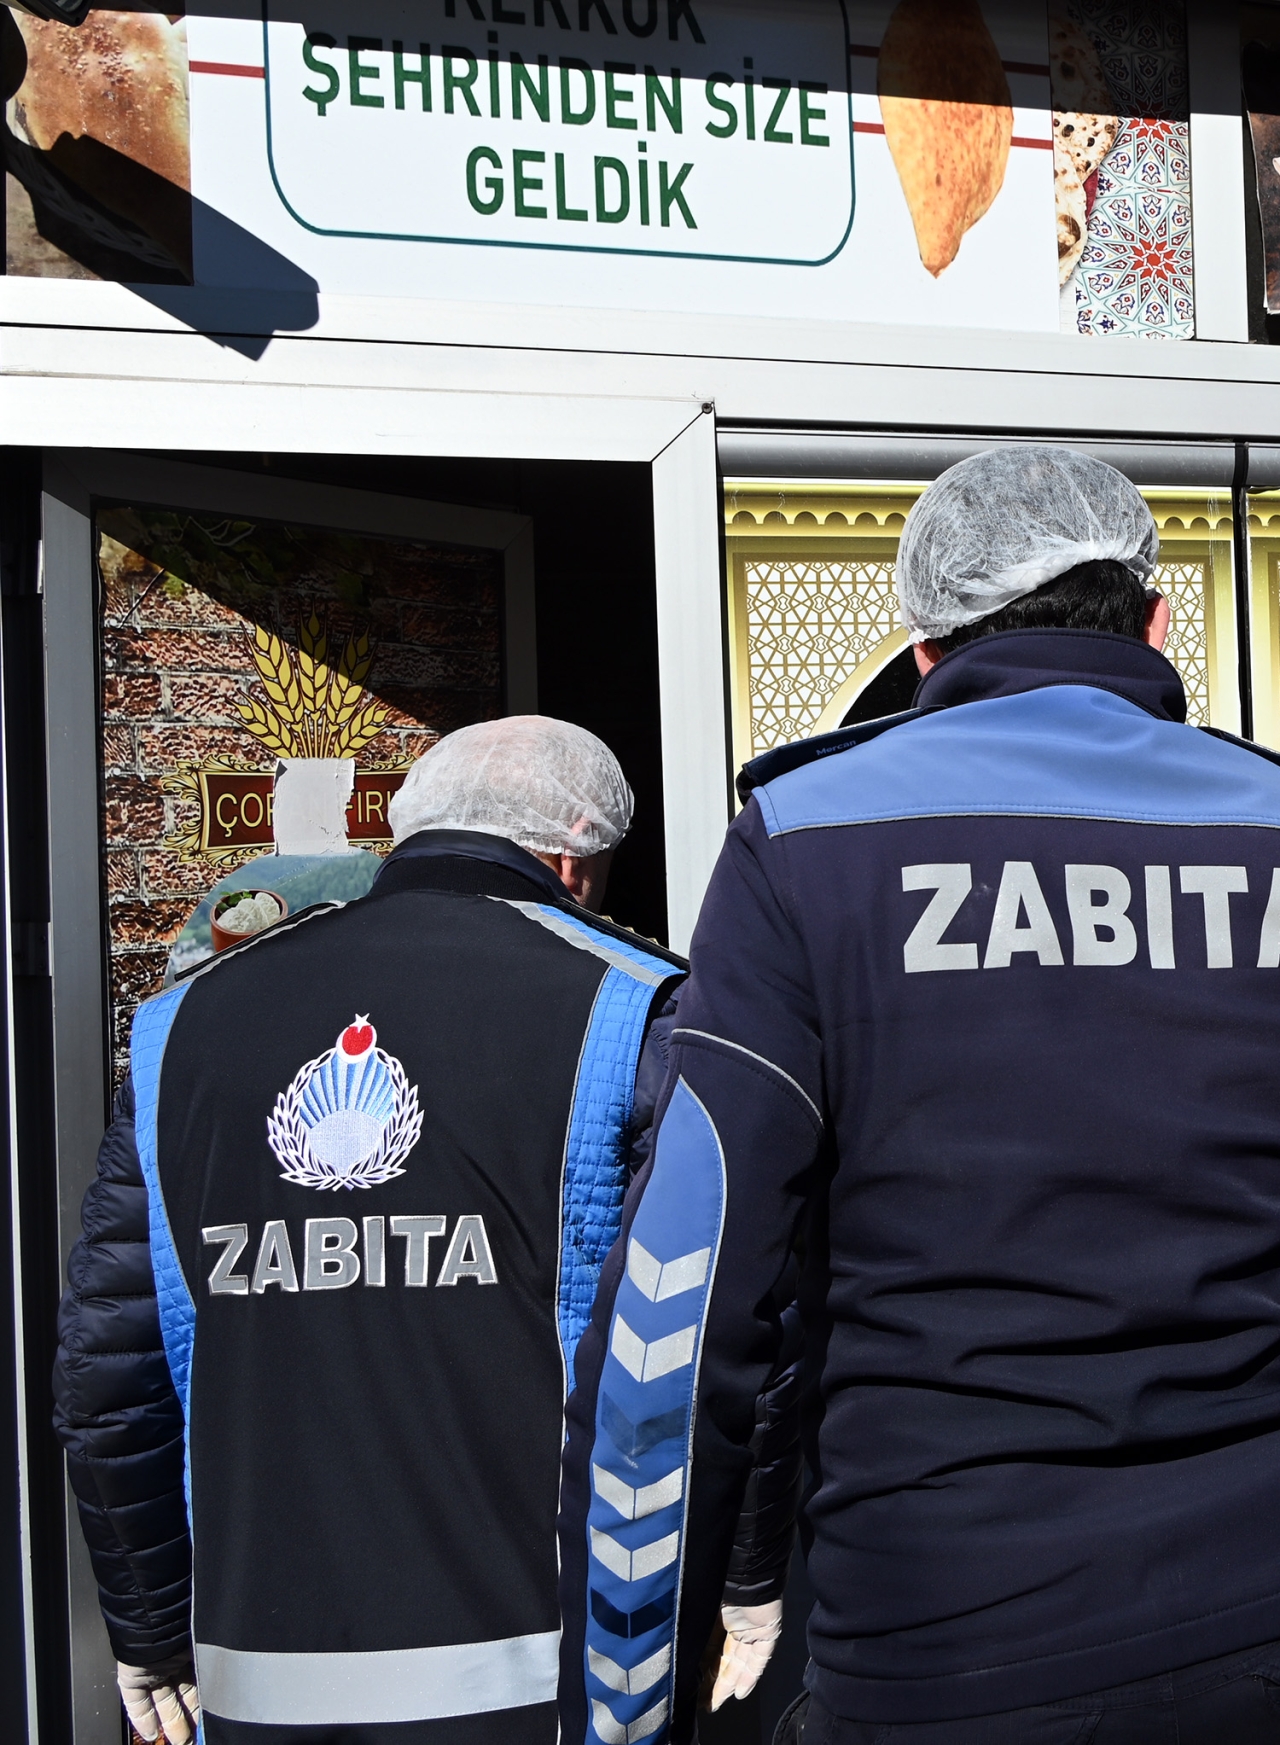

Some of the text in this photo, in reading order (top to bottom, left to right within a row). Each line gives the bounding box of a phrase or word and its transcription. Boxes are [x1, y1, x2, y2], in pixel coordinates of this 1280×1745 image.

[301, 30, 831, 147] ŞEHRİNDEN SİZE
[466, 141, 698, 230] GELDİK
[201, 1214, 500, 1297] ZABITA
